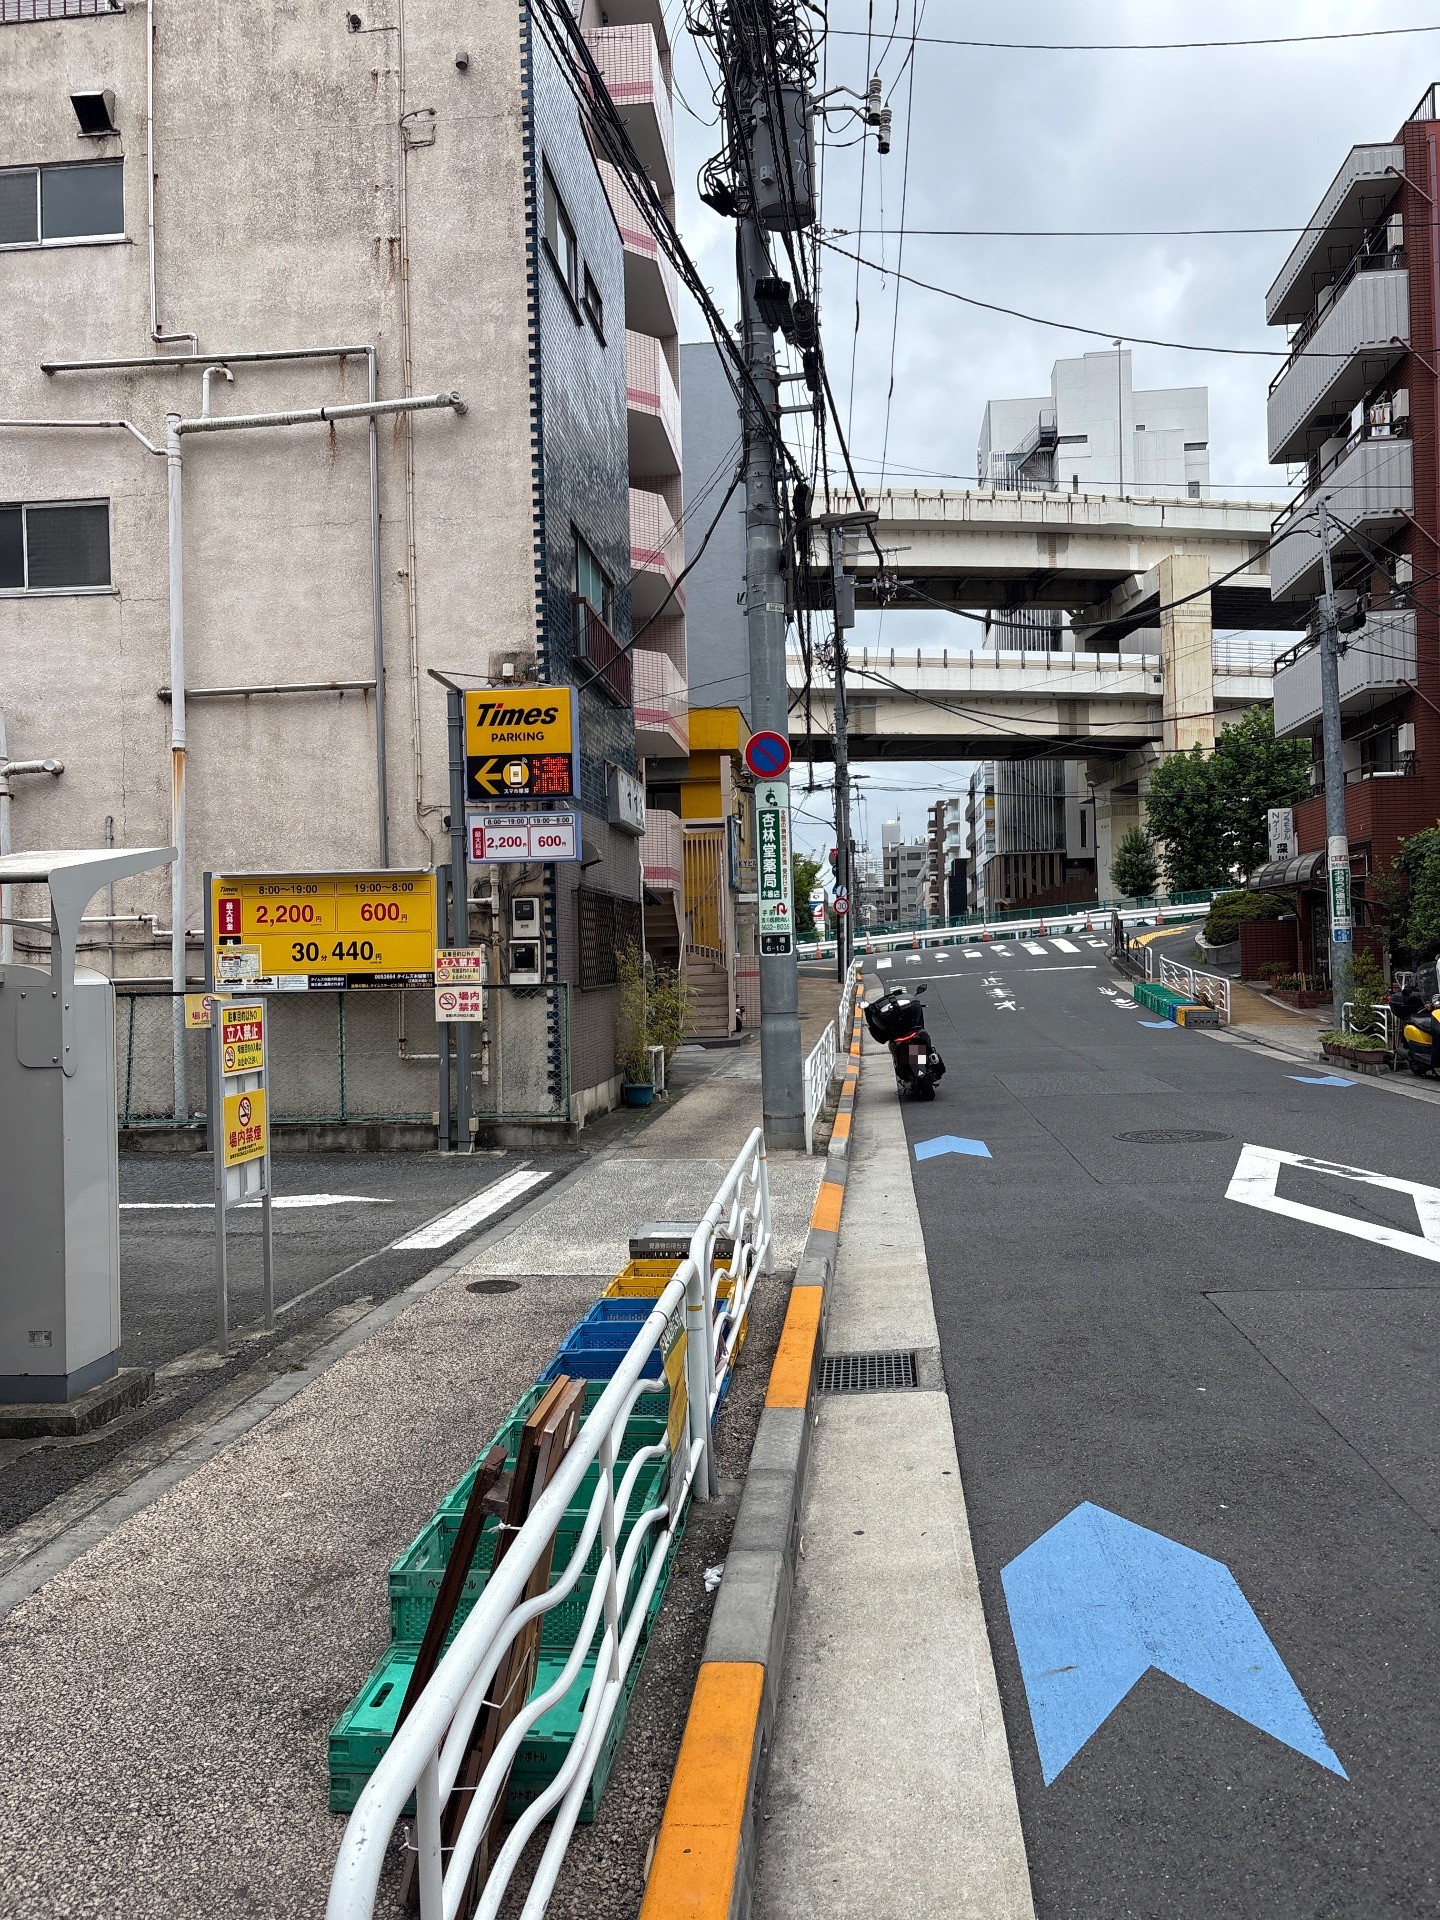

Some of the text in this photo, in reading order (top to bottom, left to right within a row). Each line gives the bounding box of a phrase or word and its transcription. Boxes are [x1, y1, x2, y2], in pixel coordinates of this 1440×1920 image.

[477, 703, 559, 727] Times
[491, 732, 545, 742] PARKING
[533, 756, 569, 794] 満
[474, 831, 482, 856] 最大料金
[761, 812, 777, 889] 杏林堂薬局
[225, 902, 234, 931] 最大料金
[837, 902, 847, 911] 30
[440, 958, 476, 967] 立入禁止
[458, 991, 480, 1000] 場内
[192, 1011, 212, 1020] 場内
[458, 1002, 480, 1012] 禁煙
[227, 1023, 259, 1043] 立入禁止
[229, 1125, 262, 1148] 場内禁煙
